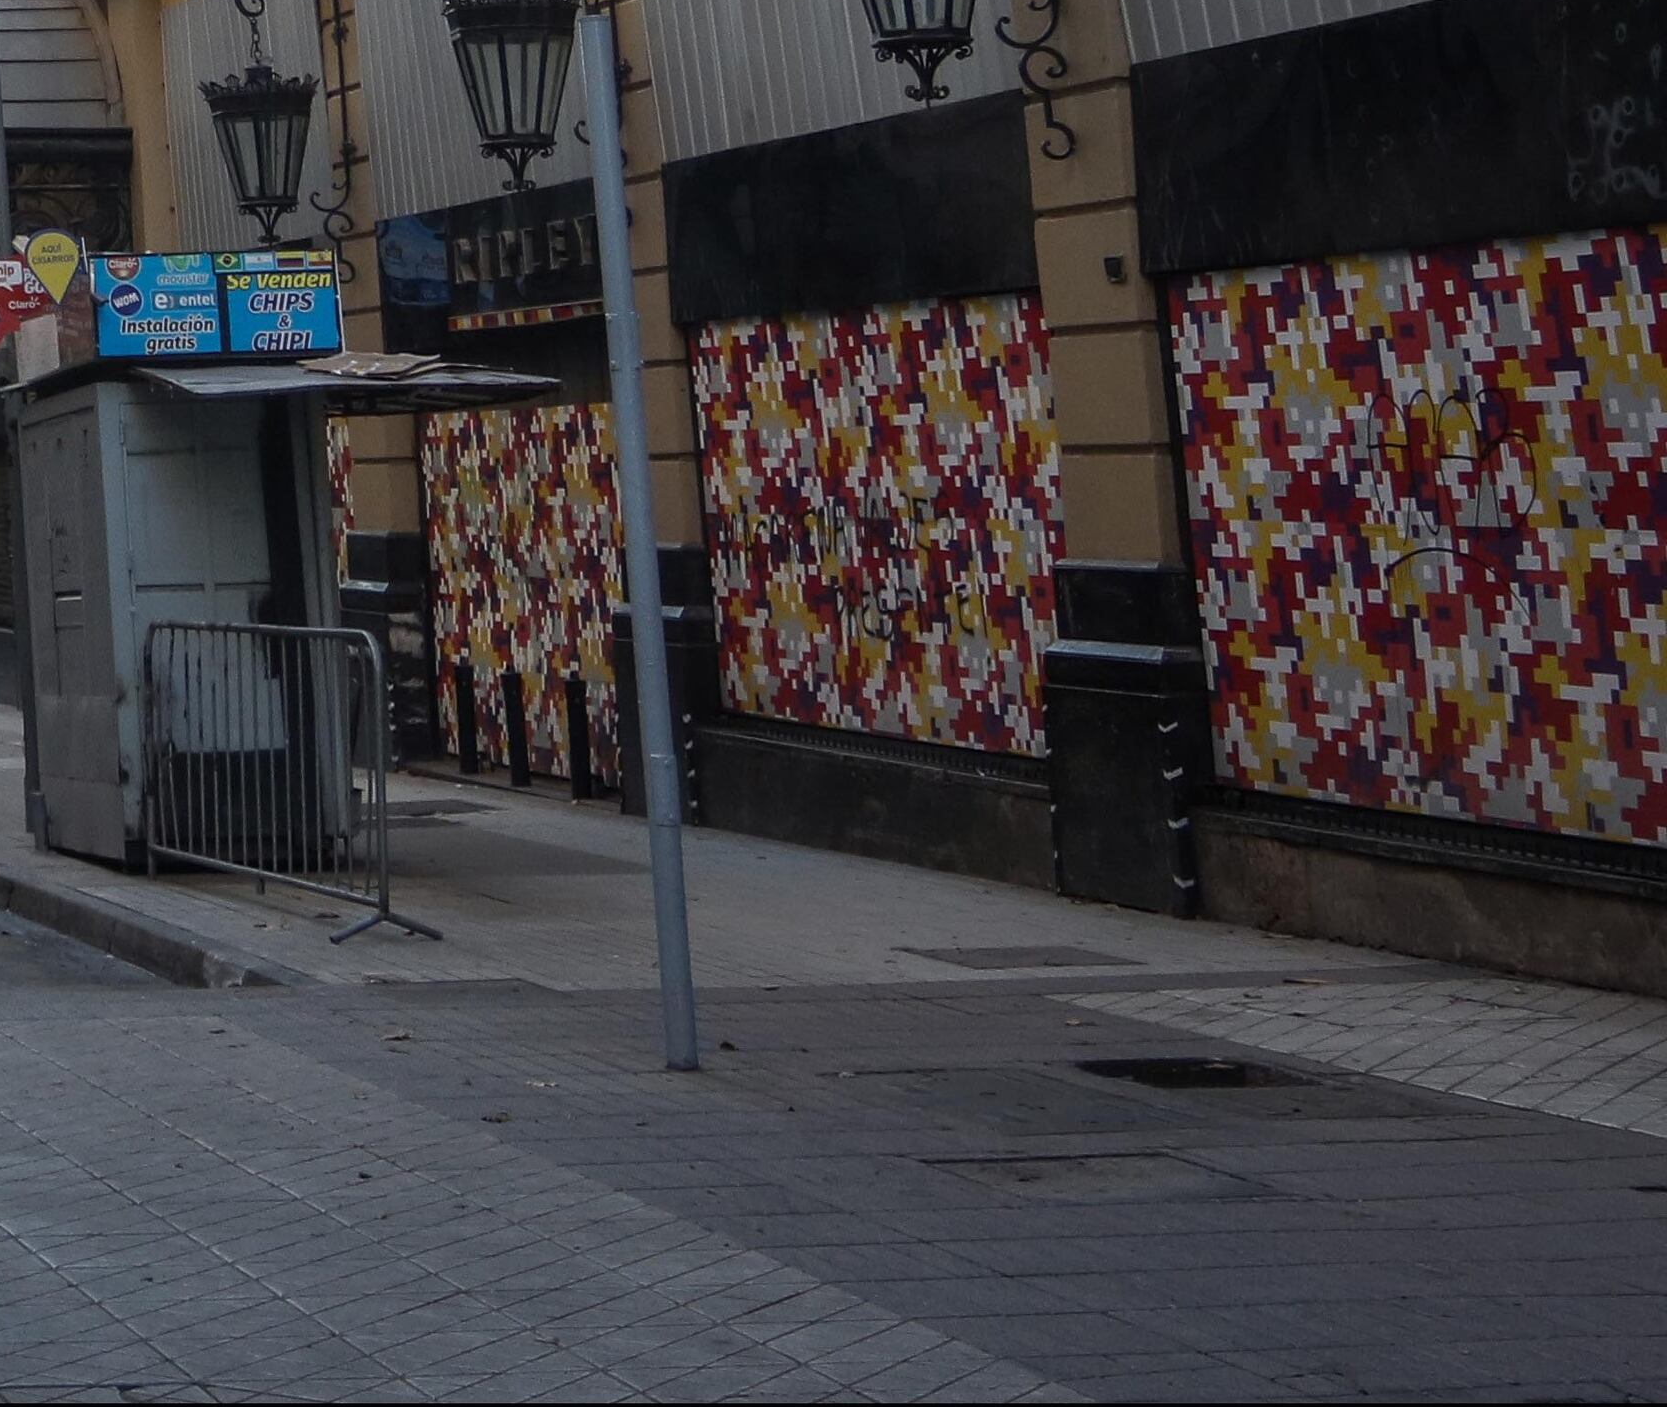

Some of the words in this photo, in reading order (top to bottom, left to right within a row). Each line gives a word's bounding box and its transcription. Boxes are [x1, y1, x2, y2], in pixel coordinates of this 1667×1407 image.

[453, 212, 596, 285] RIPLEY
[156, 273, 209, 286] movistar
[226, 275, 252, 290] Se
[256, 272, 332, 289] Venden
[8, 297, 40, 311] Claro
[113, 292, 140, 309] WOM
[178, 294, 217, 307] entel
[248, 290, 315, 314] CHIPS
[120, 315, 215, 335] Instalación
[278, 314, 292, 330] &
[145, 335, 197, 356] gratis
